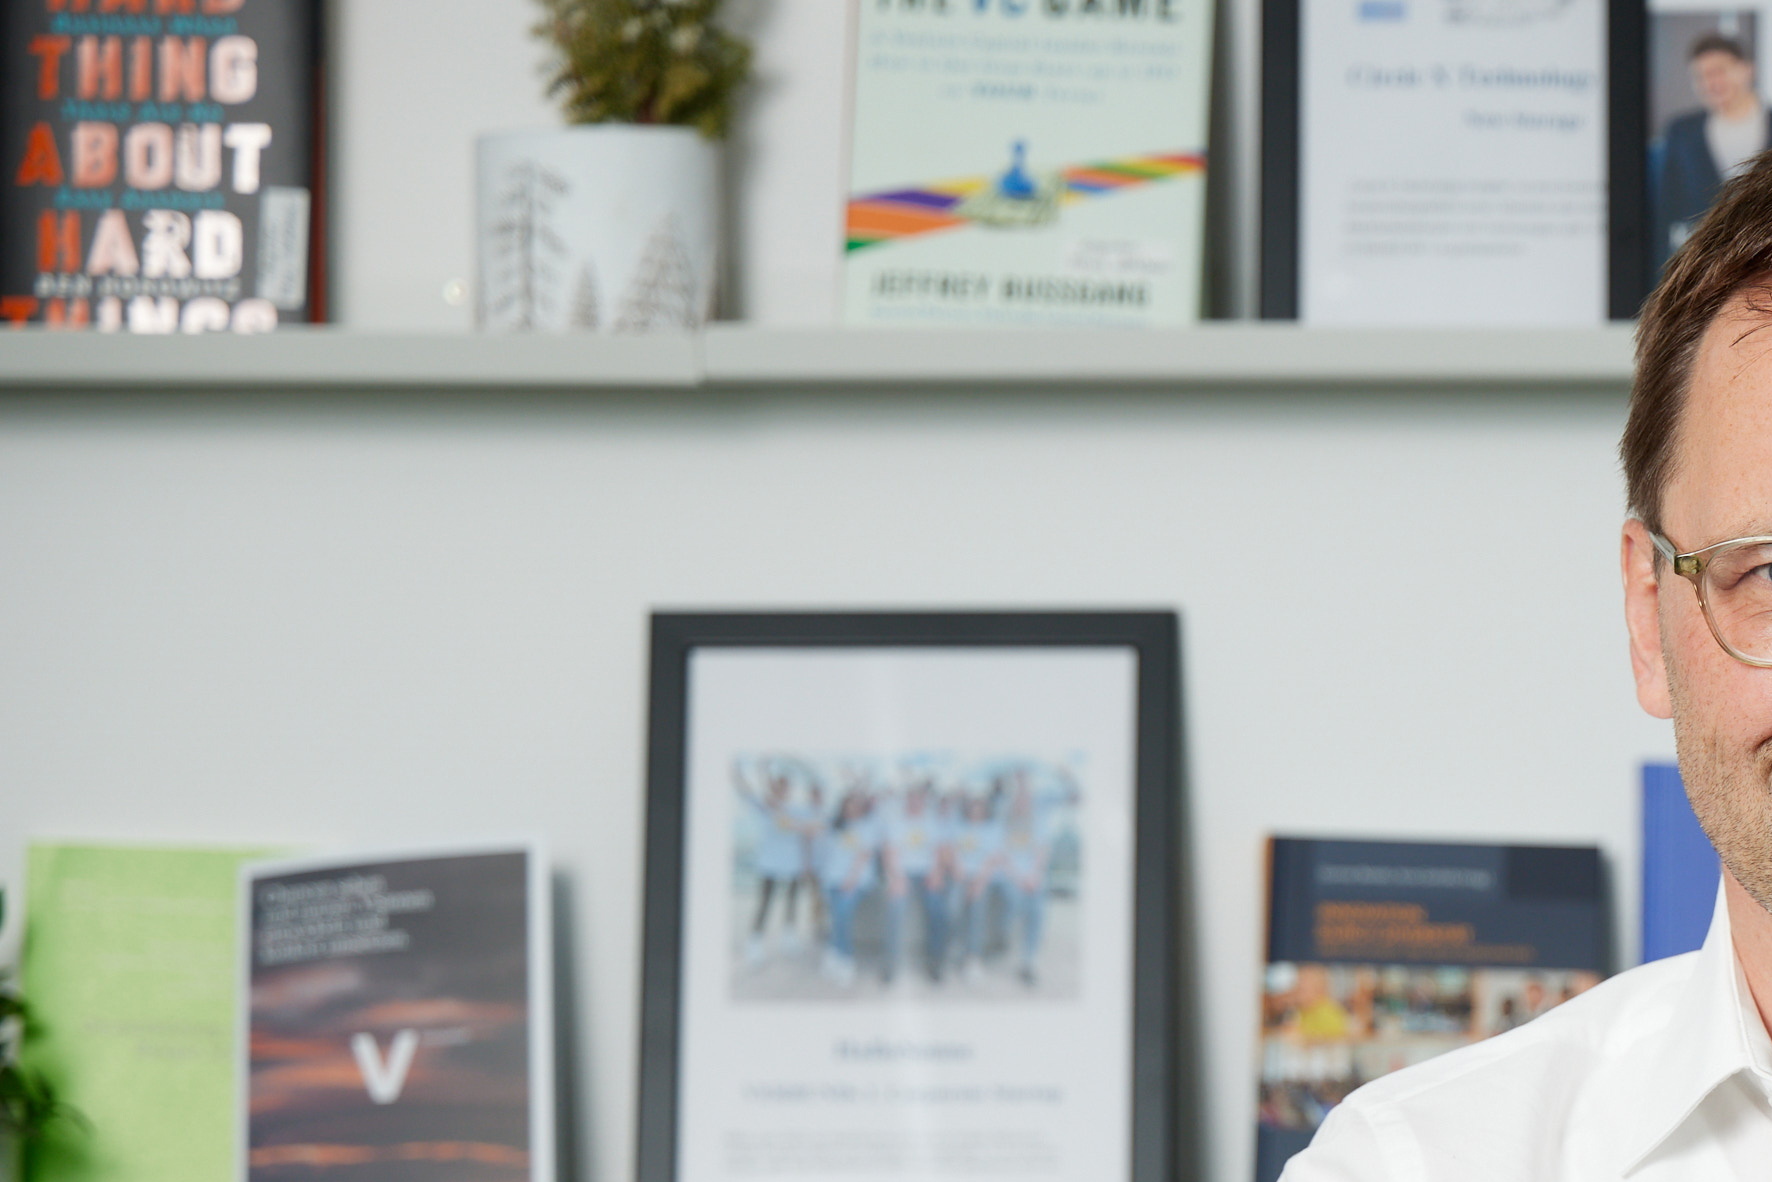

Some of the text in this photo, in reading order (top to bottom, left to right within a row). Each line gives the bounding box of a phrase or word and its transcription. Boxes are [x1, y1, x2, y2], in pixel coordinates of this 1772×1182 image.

[28, 34, 258, 104] THING
[14, 121, 273, 195] ABOUT
[35, 208, 244, 281] HARD
[351, 1028, 418, 1104] V
